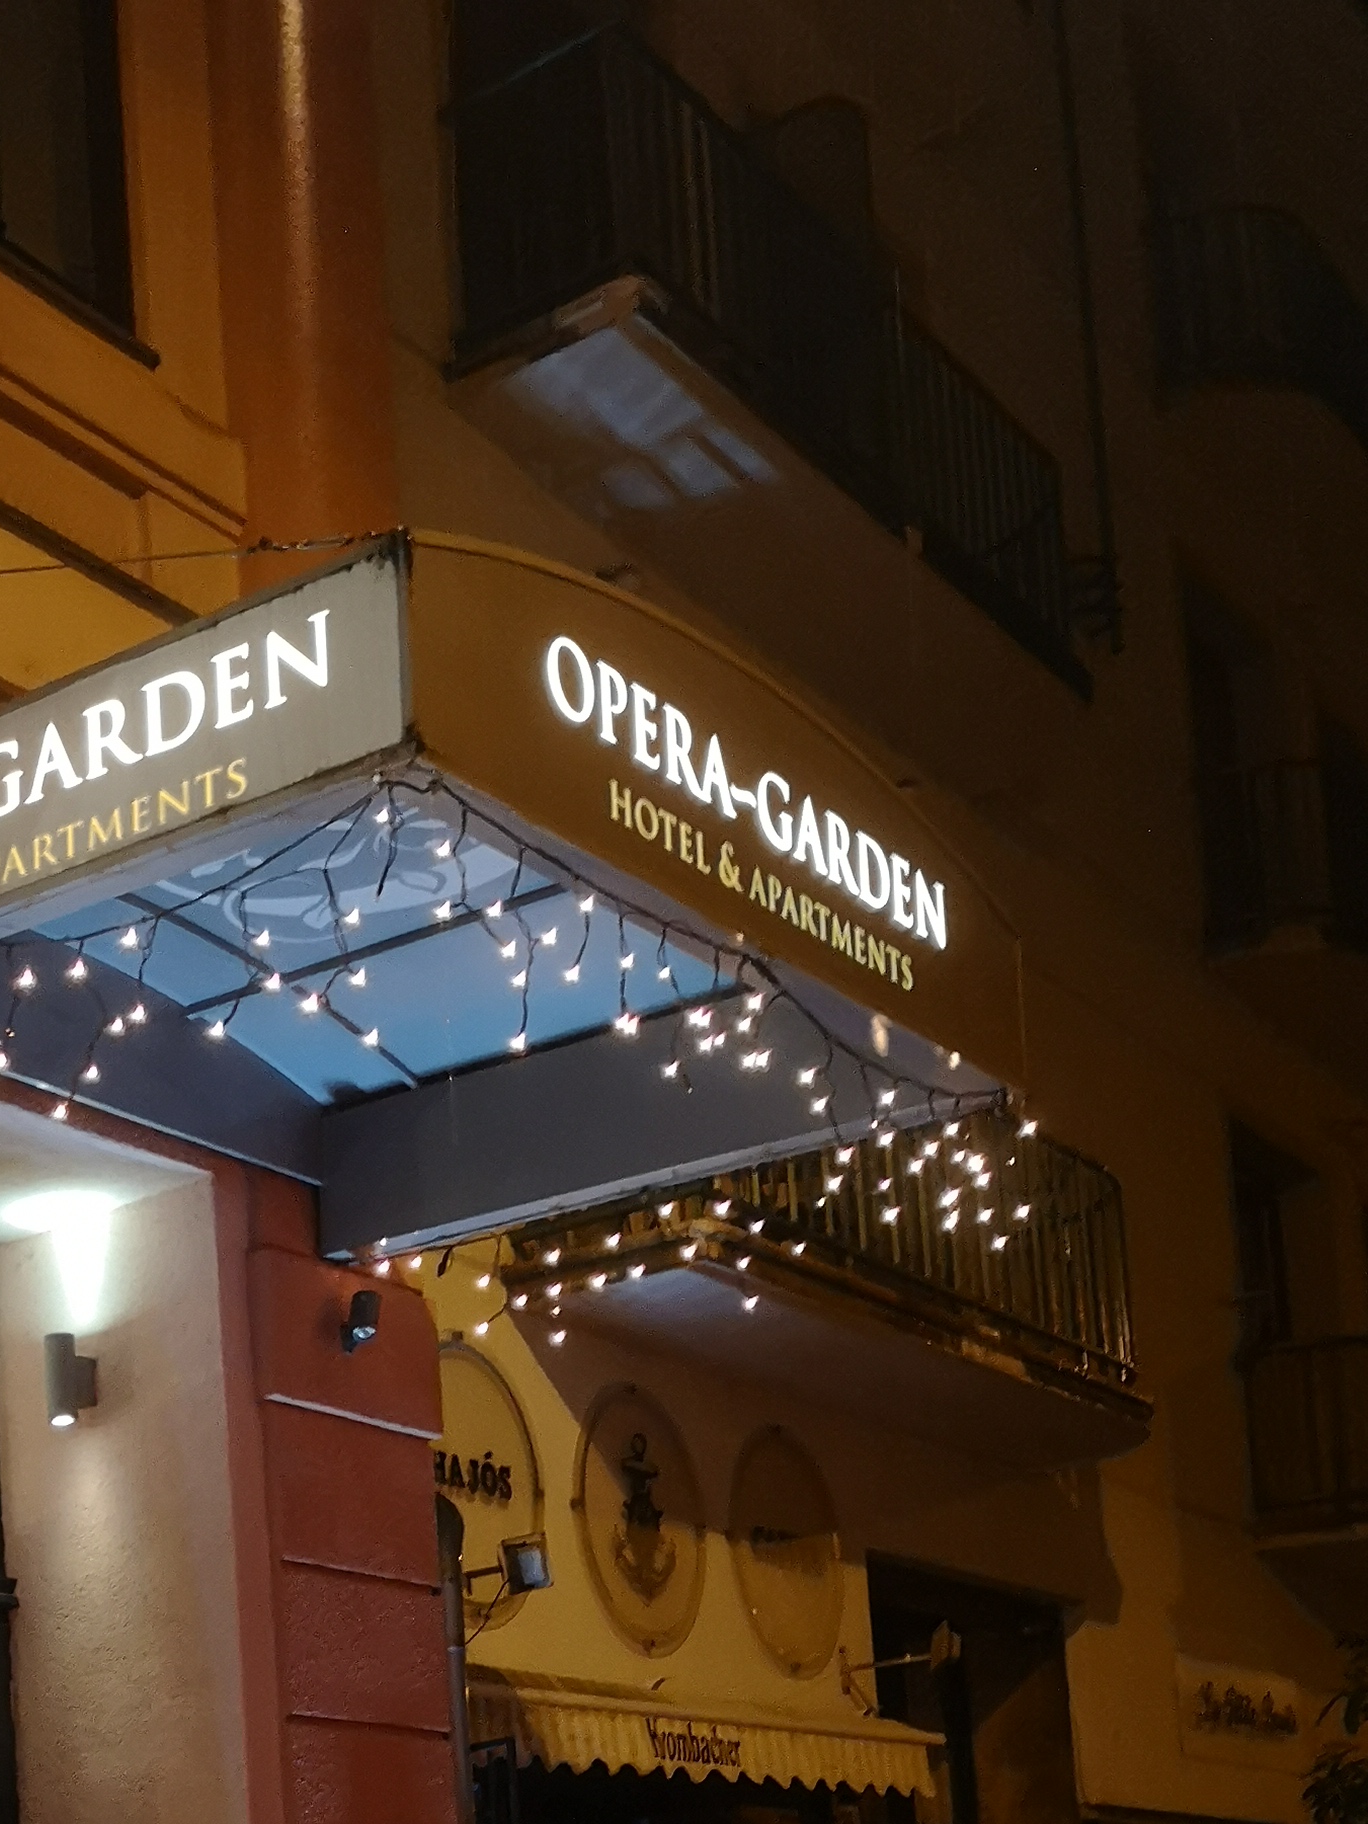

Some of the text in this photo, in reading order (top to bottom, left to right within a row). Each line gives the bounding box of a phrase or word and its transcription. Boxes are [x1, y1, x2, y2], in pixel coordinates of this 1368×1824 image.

[546, 634, 948, 951] OPERA-GARDEN
[608, 778, 914, 992] HOTEL & APARTMENTS
